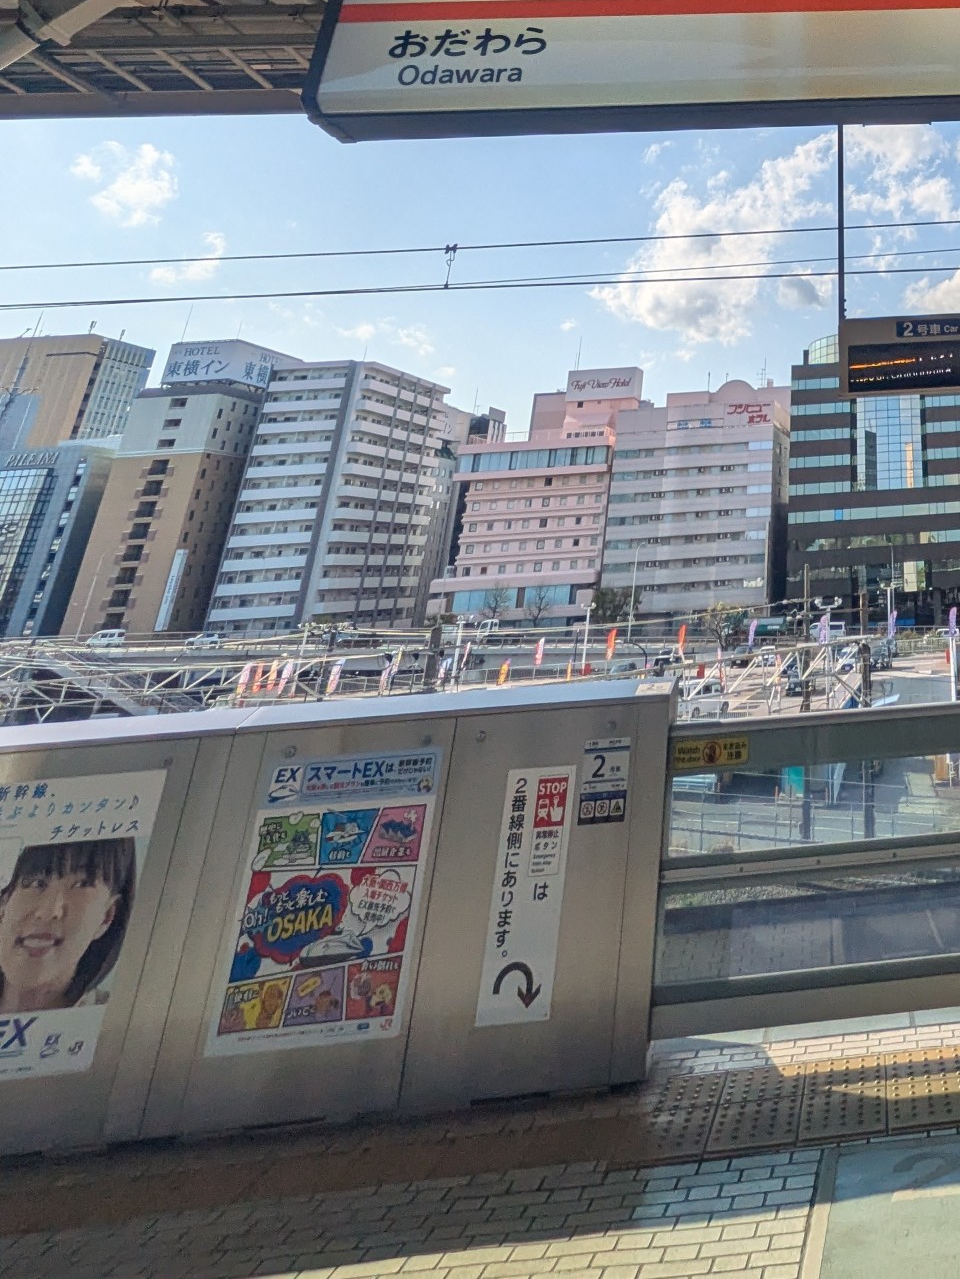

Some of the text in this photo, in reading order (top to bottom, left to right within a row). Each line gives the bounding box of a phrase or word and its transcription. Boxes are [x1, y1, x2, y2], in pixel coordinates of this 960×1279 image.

[388, 26, 548, 59] おだわら
[398, 63, 523, 87] Odawara
[943, 325, 958, 334] Car
[184, 346, 220, 357] HOTEL
[166, 360, 230, 378] 東横イン
[242, 361, 270, 384] 東横
[571, 377, 632, 392] Fuji View Hotel
[275, 767, 301, 784] EX
[592, 755, 606, 778] 2
[538, 782, 567, 795] STOP
[50, 820, 138, 840] チケットレス
[535, 829, 560, 840] 異常停止
[534, 841, 558, 851] ボタン
[495, 777, 528, 958] 2番線側にあります。
[533, 882, 549, 901] は
[243, 909, 269, 929] Oh!
[267, 903, 334, 943] OSAKA
